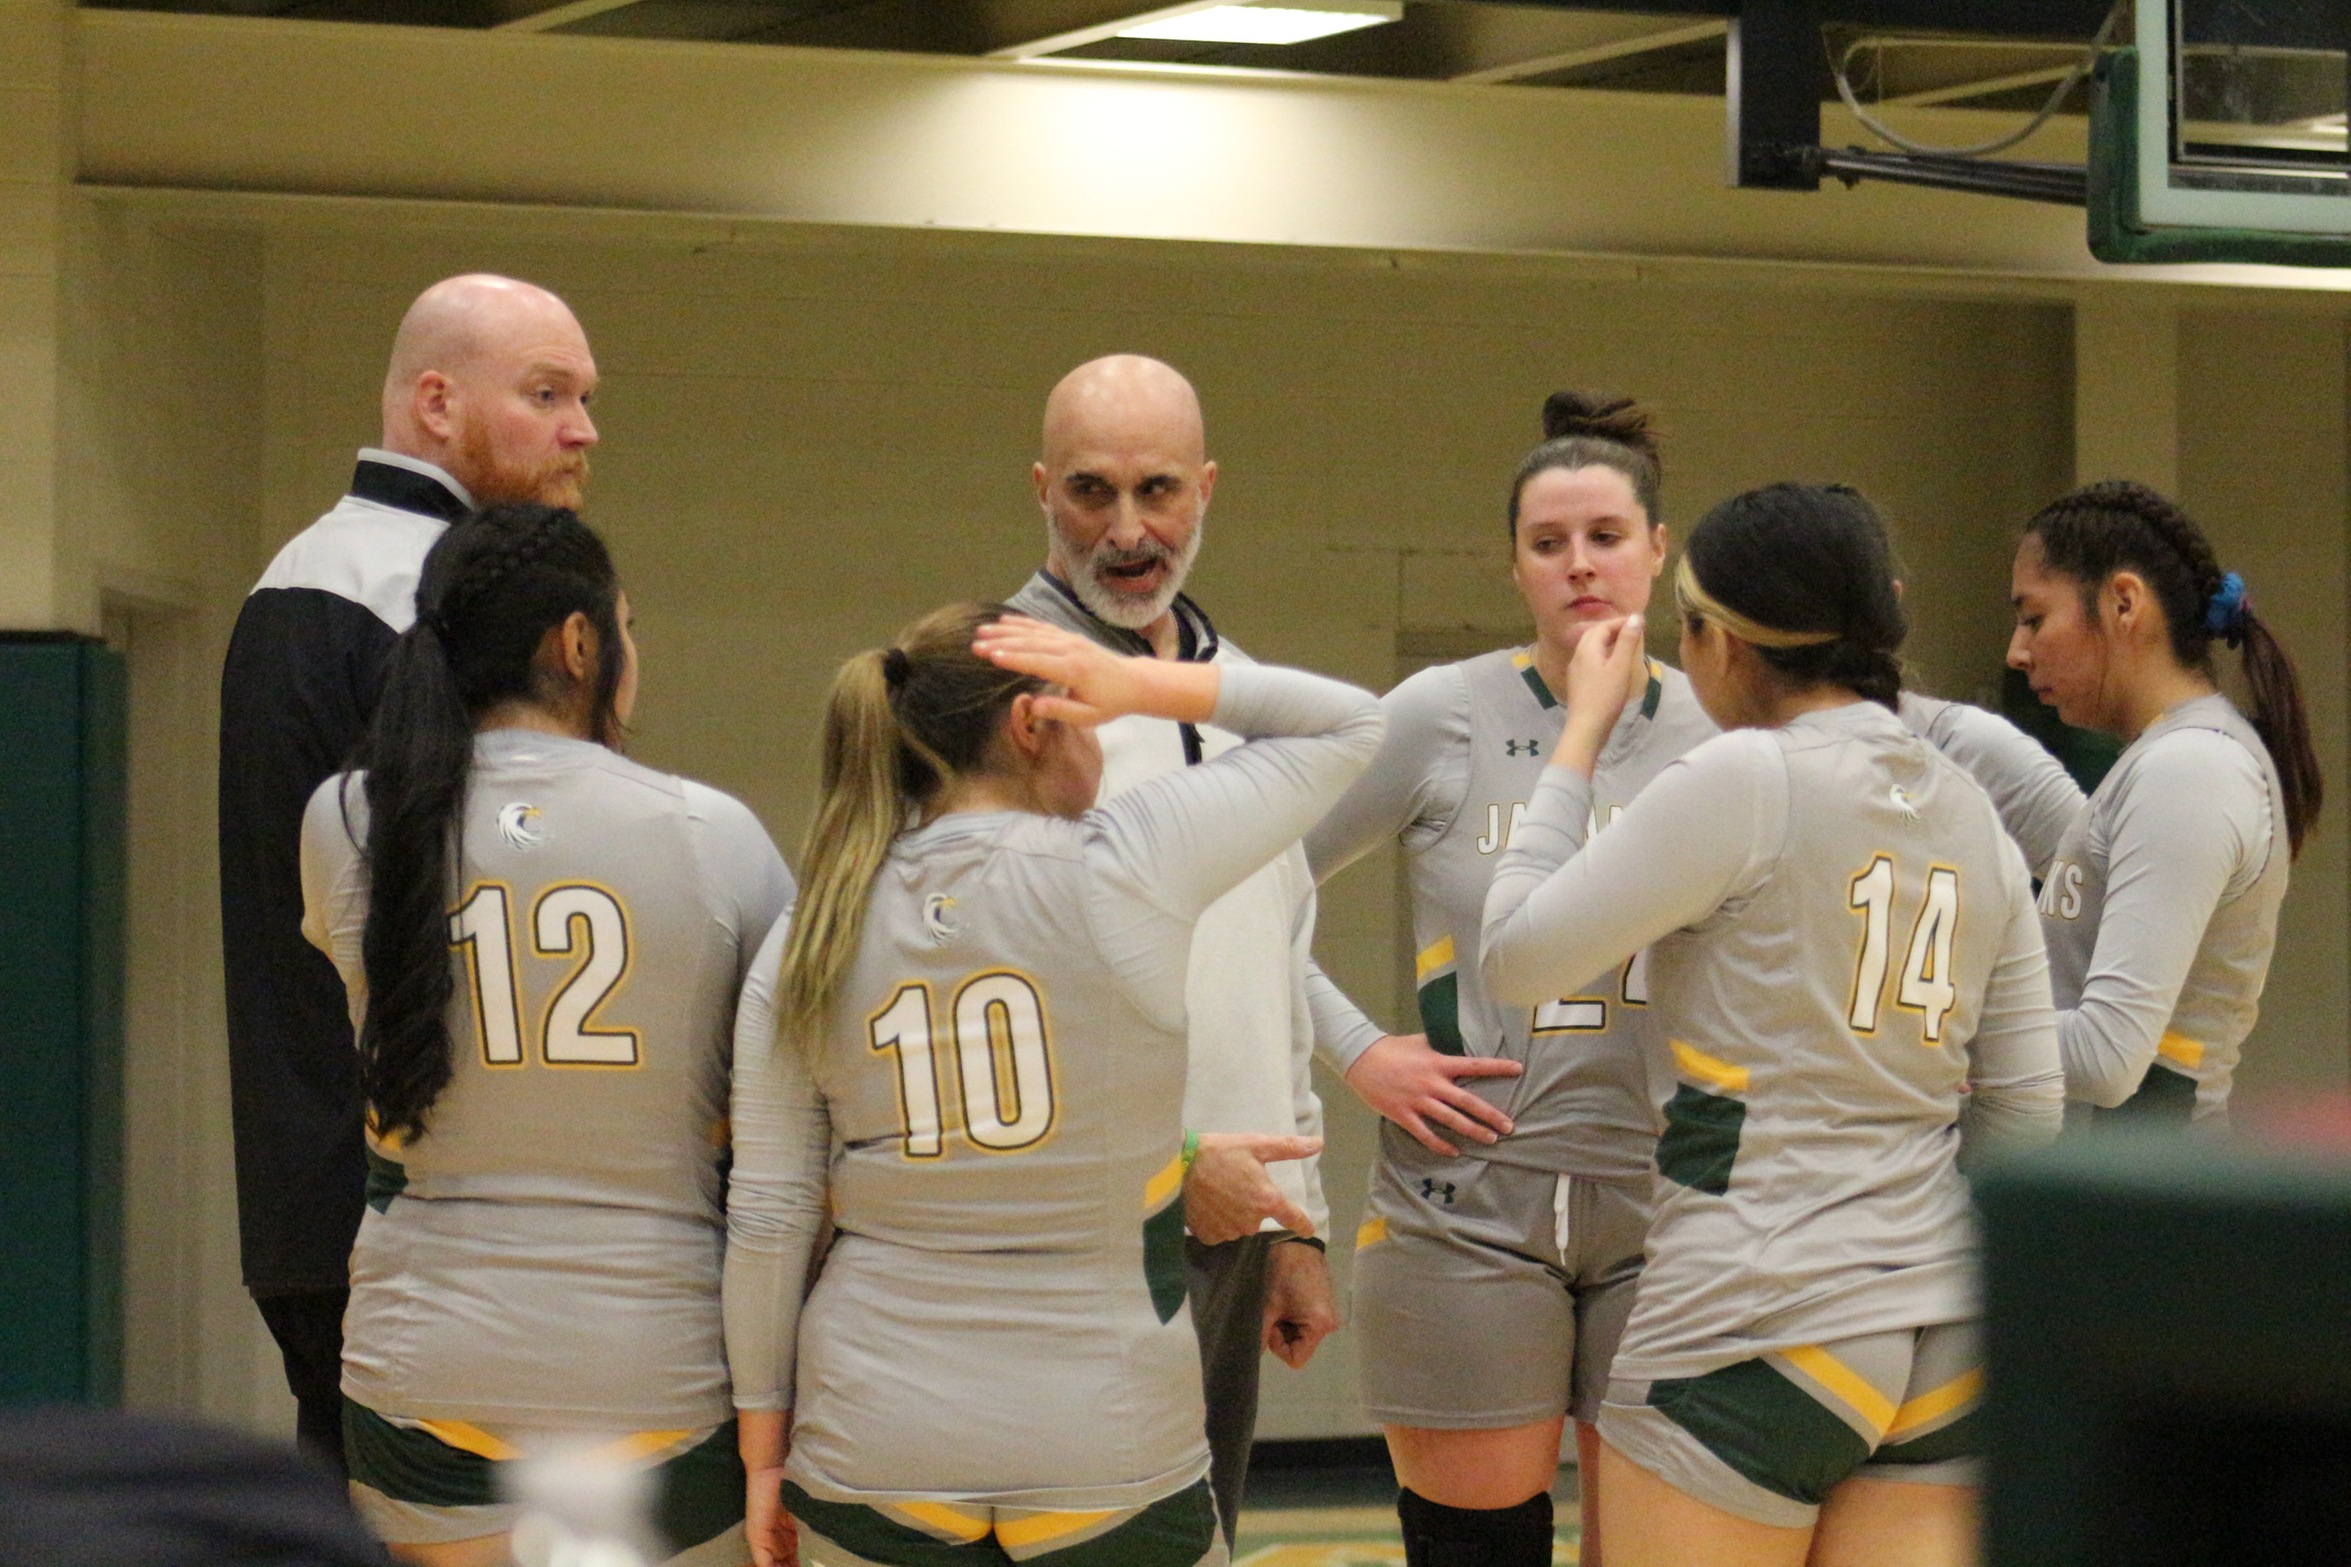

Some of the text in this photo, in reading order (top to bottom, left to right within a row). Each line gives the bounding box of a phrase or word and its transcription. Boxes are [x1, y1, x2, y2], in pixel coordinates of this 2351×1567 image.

[447, 881, 642, 1069] 12
[1849, 851, 1959, 1043] 14
[868, 967, 1056, 1160] 10
